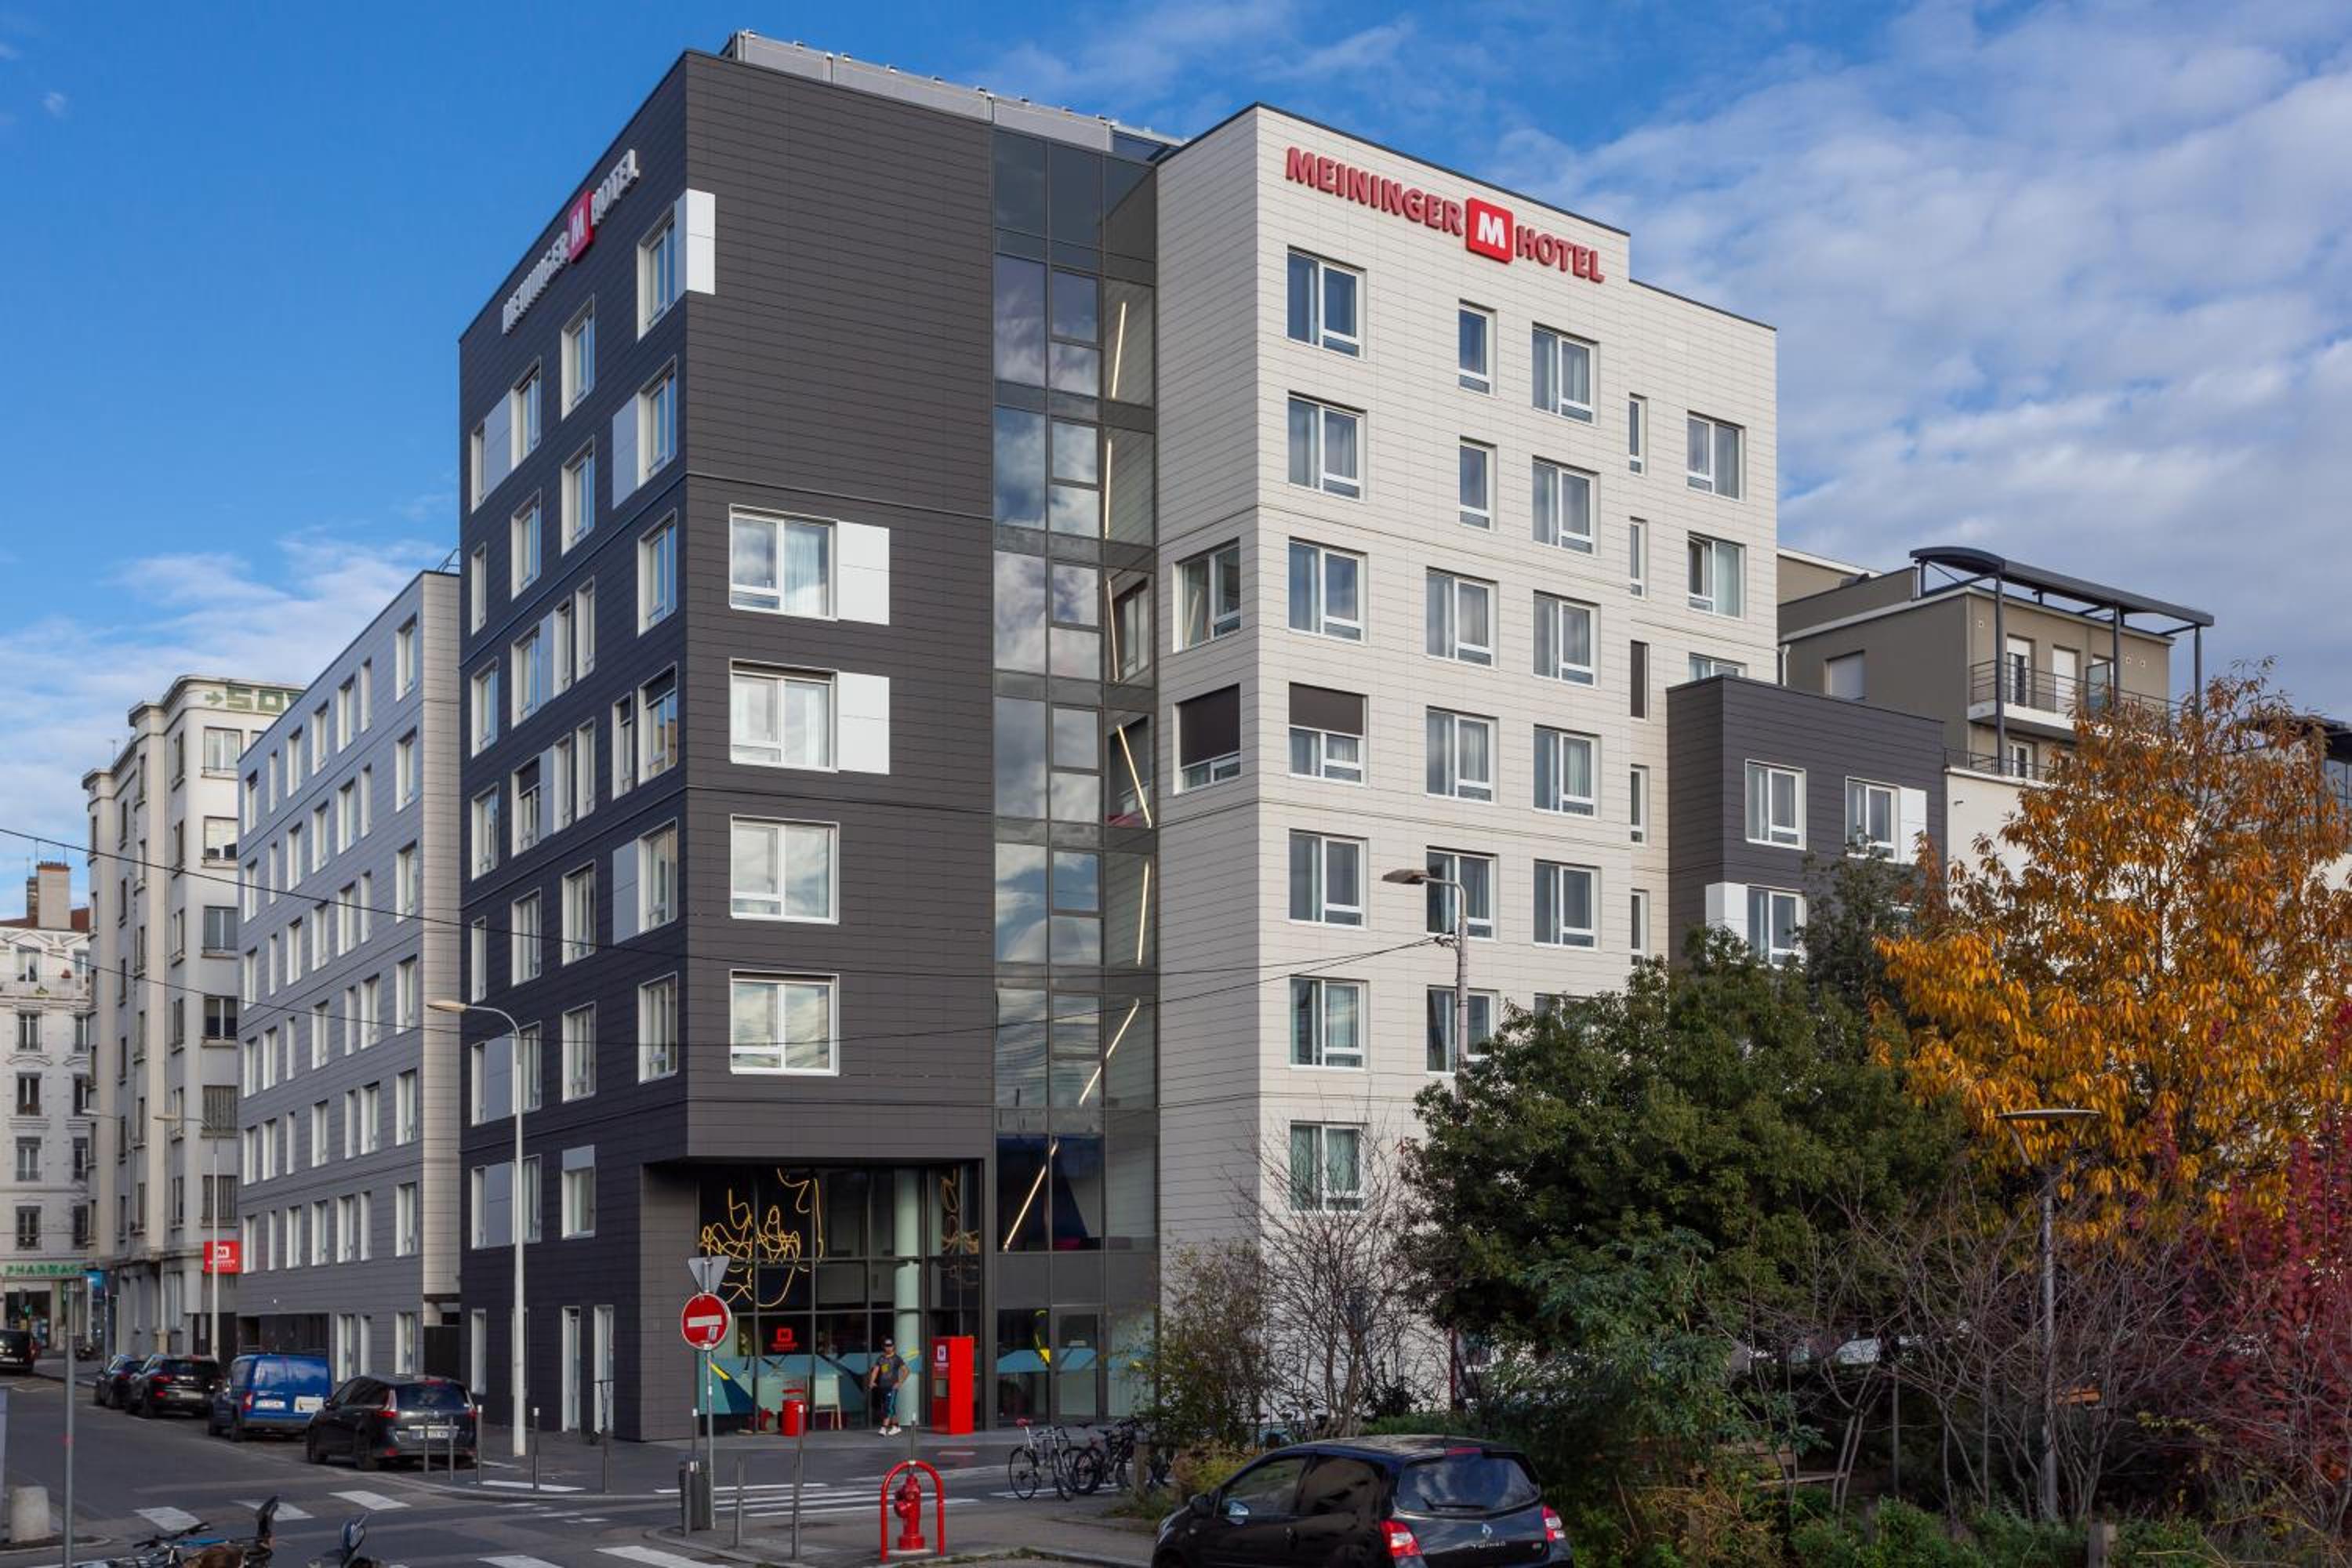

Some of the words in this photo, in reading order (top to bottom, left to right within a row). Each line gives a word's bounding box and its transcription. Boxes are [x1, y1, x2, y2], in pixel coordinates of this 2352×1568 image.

[572, 208, 585, 247] M
[1286, 147, 1465, 237] MEININGER
[1477, 210, 1506, 249] M
[1516, 225, 1605, 283] HOTEL
